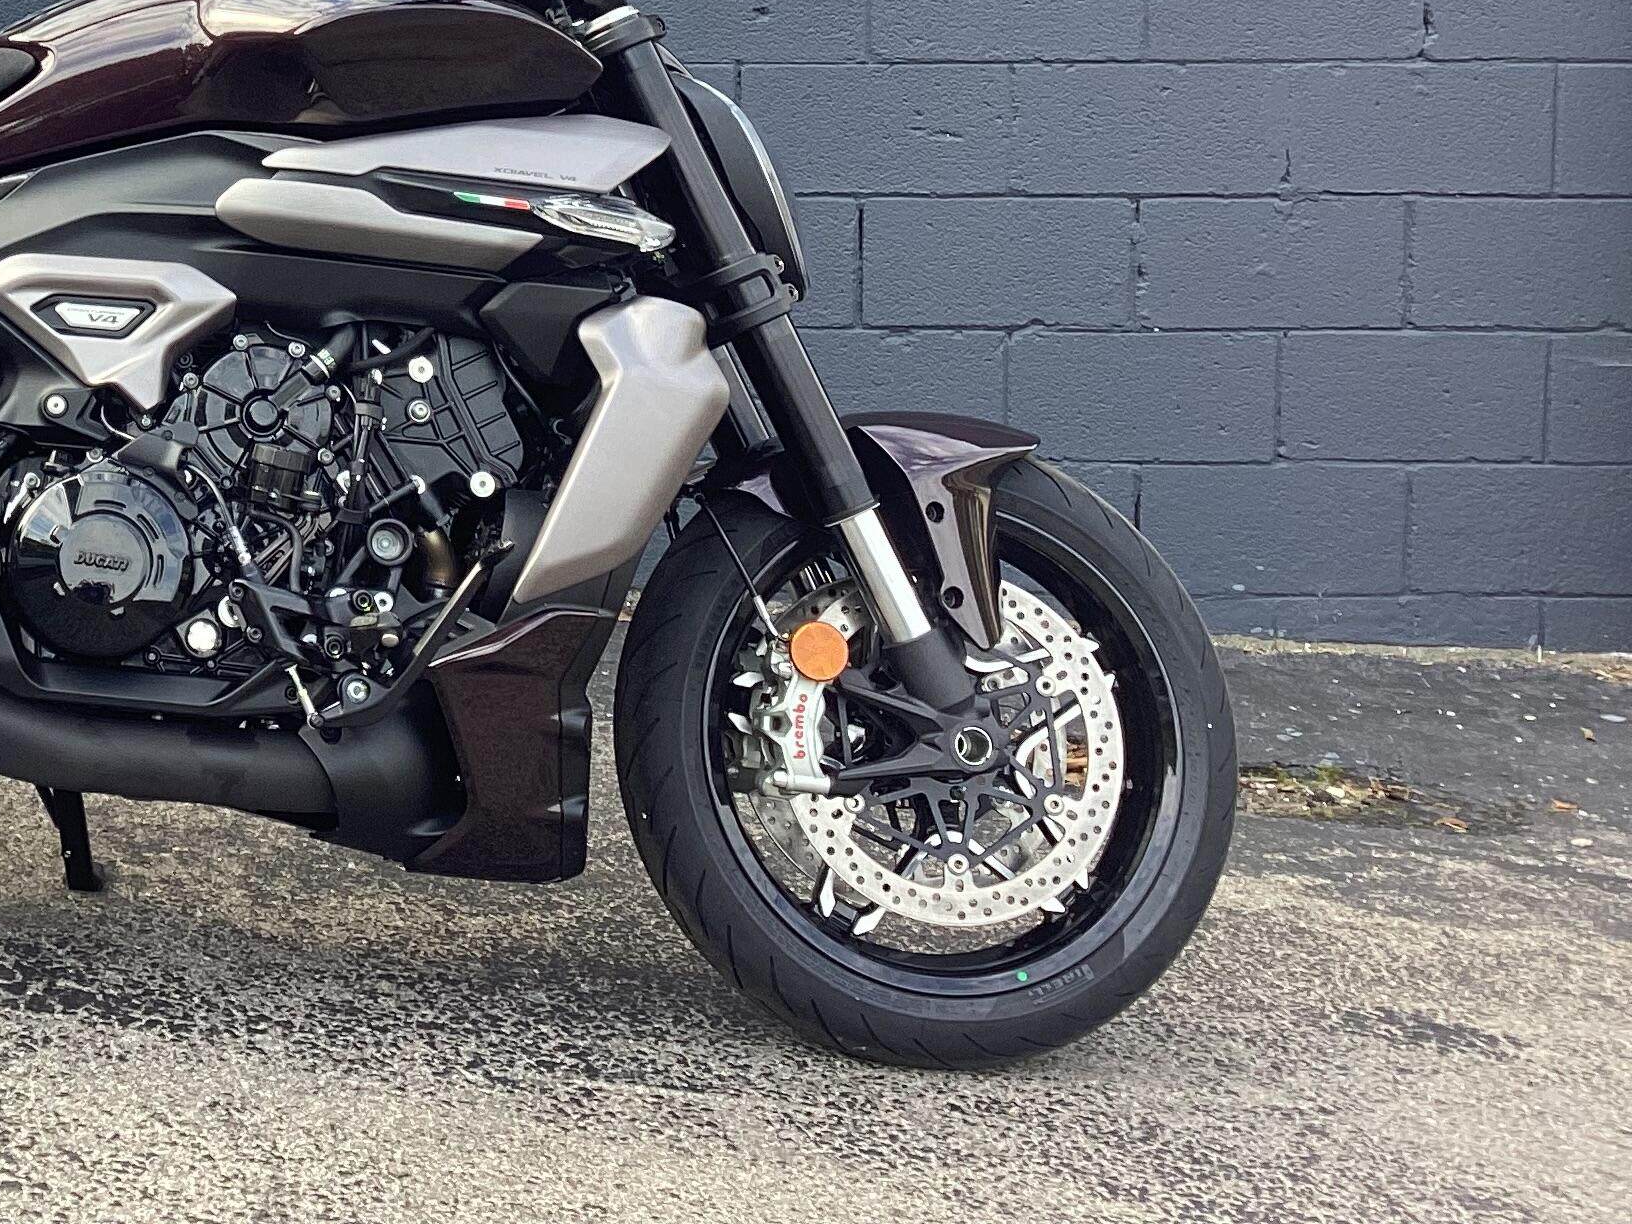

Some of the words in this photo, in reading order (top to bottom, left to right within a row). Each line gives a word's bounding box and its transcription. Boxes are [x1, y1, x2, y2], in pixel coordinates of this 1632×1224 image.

[88, 313, 119, 325] V4
[74, 551, 129, 572] DUCATI
[792, 692, 809, 760] brembo
